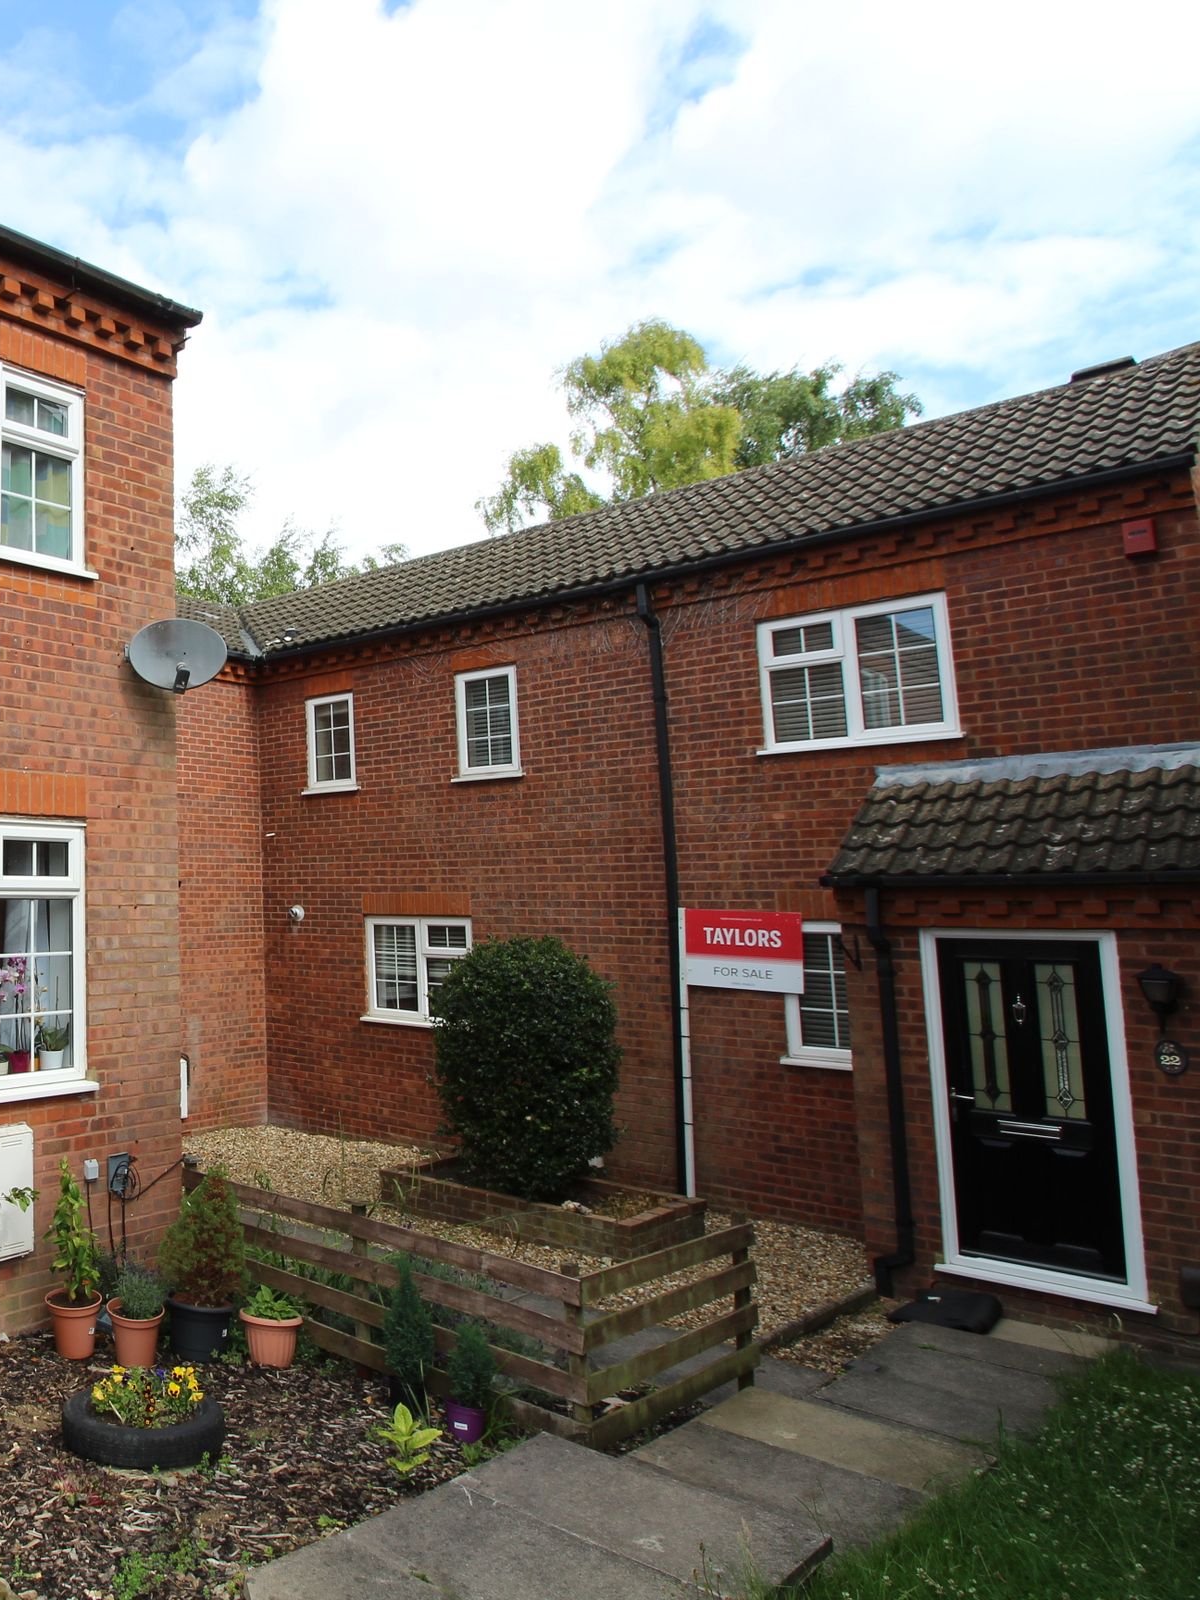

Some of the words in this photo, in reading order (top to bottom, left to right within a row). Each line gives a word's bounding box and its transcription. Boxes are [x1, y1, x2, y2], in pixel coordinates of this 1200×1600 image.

[703, 927, 782, 949] TAYLORS
[713, 966, 738, 977] FOR
[742, 968, 774, 980] SALE
[1160, 1055, 1181, 1066] 22
